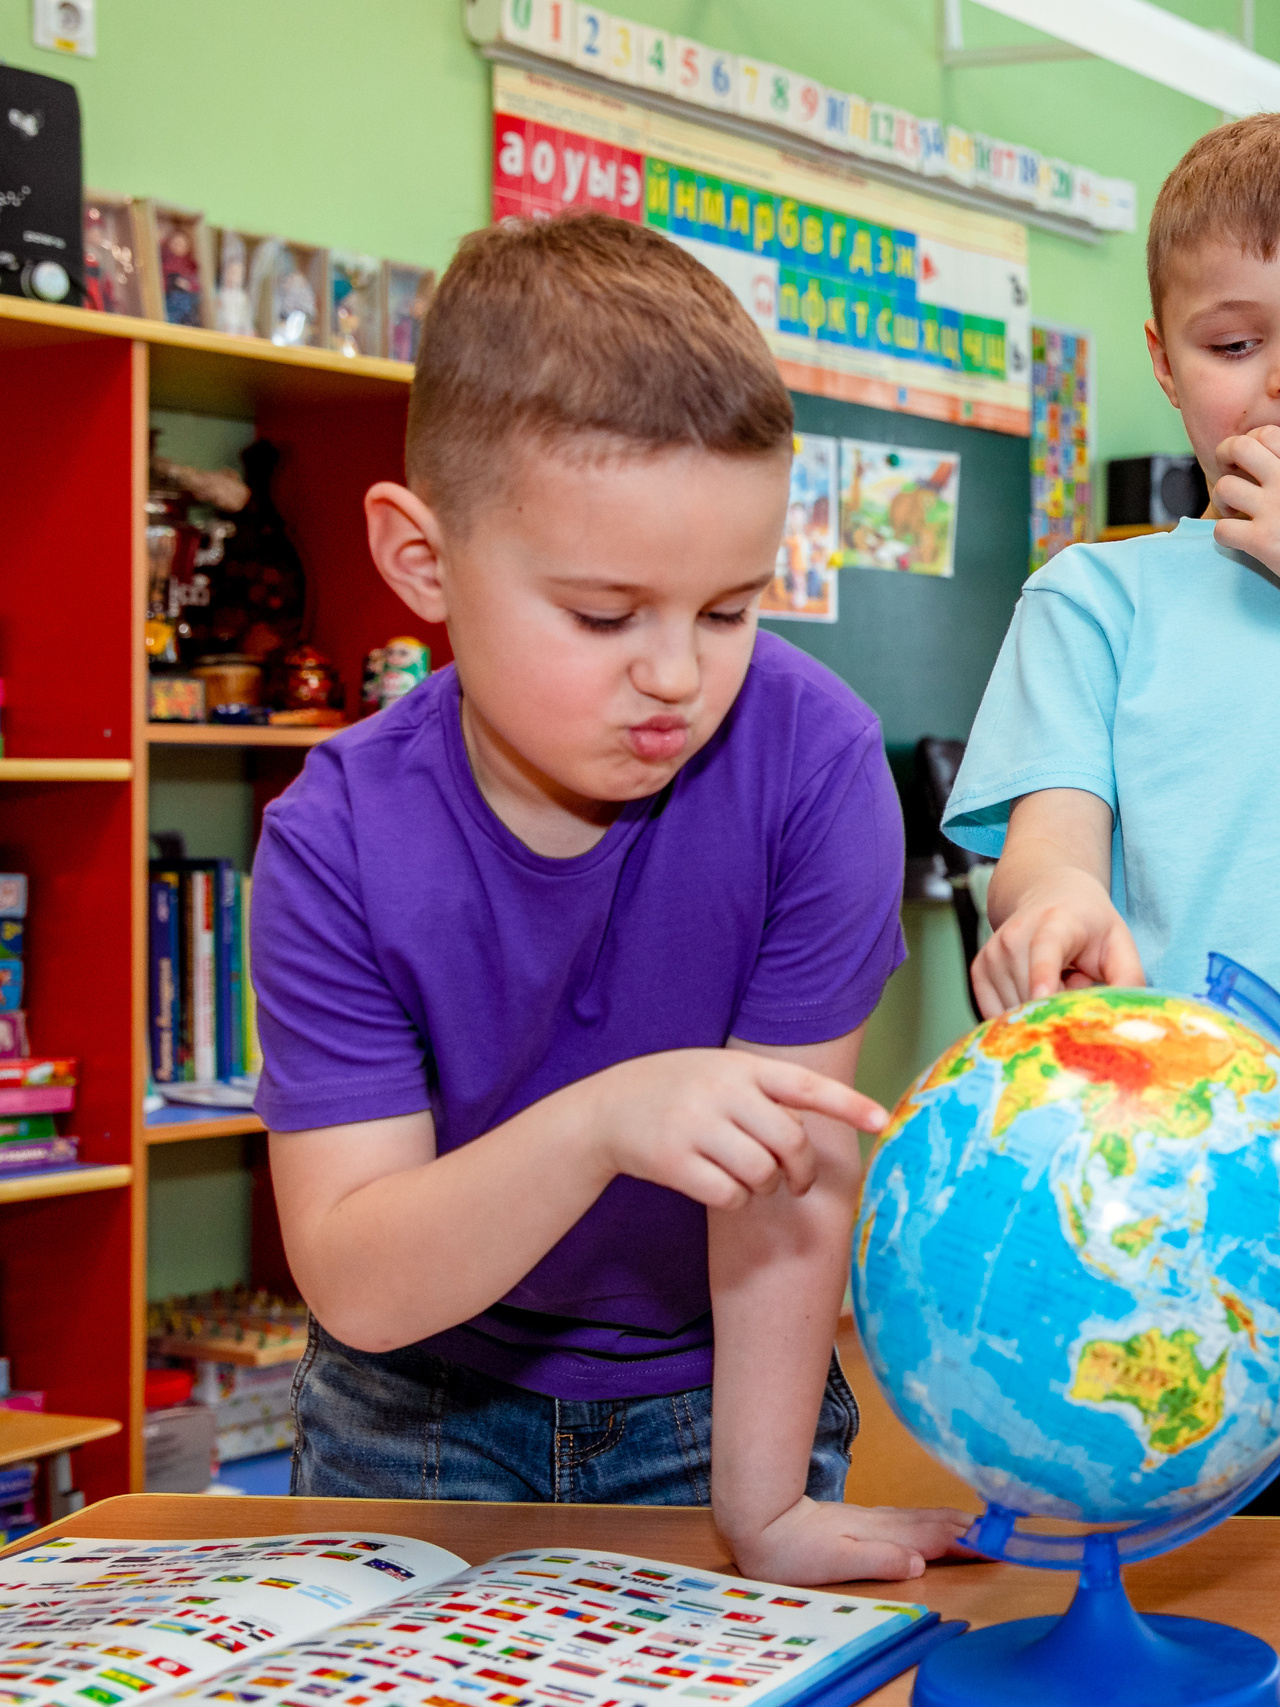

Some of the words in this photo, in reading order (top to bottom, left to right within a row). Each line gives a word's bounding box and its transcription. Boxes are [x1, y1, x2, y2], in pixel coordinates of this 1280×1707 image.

[551, 2, 562, 42] 1
[583, 15, 600, 56] 2
[613, 26, 632, 68] 3
[648, 39, 666, 75] 4
[680, 48, 699, 88] 5
[711, 58, 731, 96] 6
[743, 65, 760, 104] 7
[770, 74, 790, 114] 8
[800, 86, 819, 122] 9
[870, 111, 895, 149] 12
